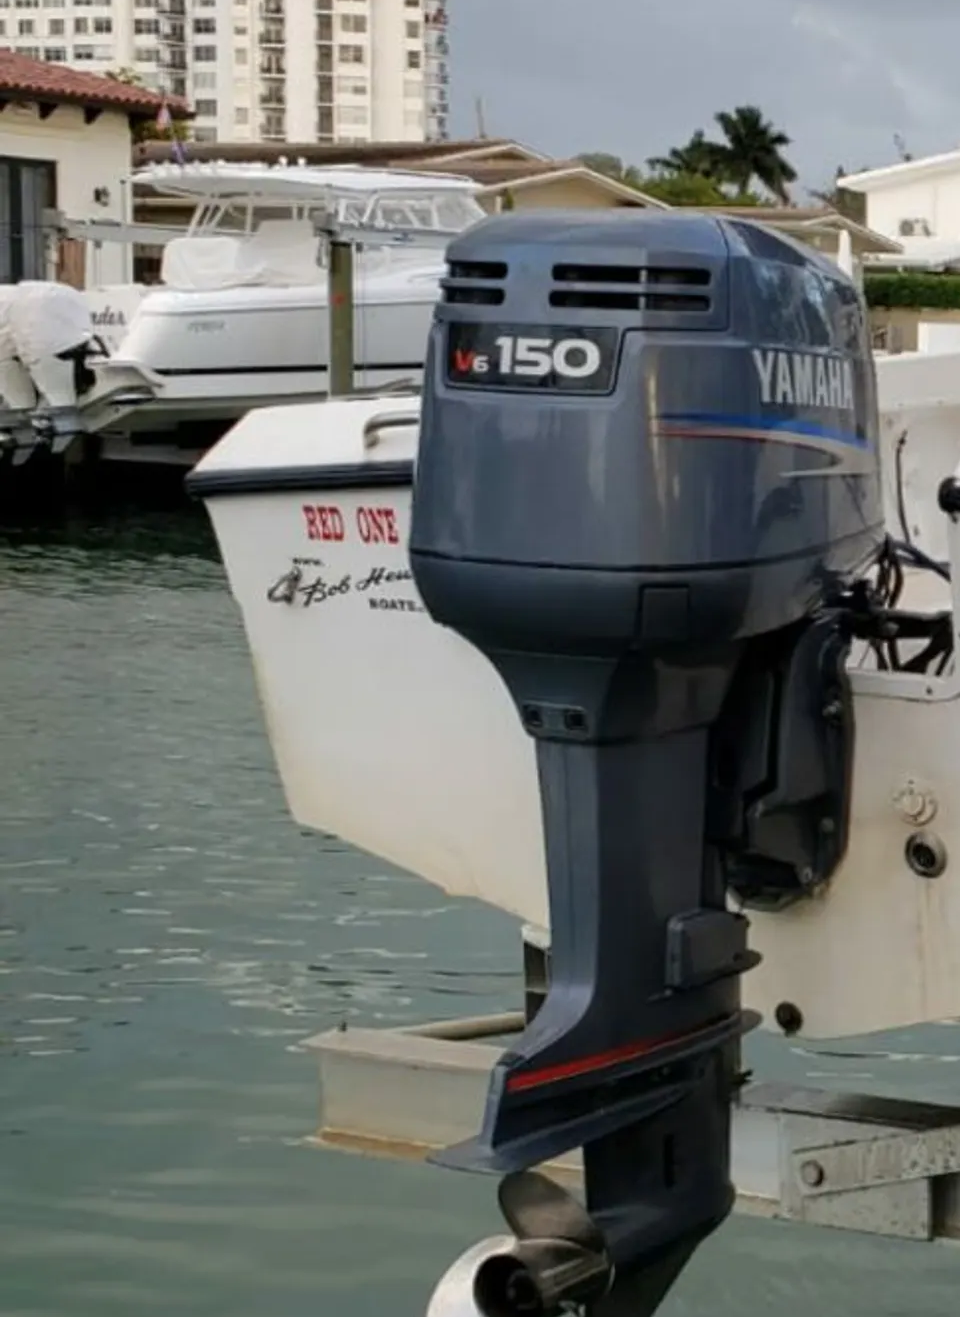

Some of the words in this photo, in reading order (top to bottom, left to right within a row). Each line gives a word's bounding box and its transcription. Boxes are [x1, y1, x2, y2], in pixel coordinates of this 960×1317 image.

[455, 348, 489, 374] V6
[495, 336, 601, 378] 150
[752, 348, 854, 410] YAMAHA
[302, 504, 345, 542] RED
[356, 506, 399, 545] ONE
[297, 575, 353, 607] Bob
